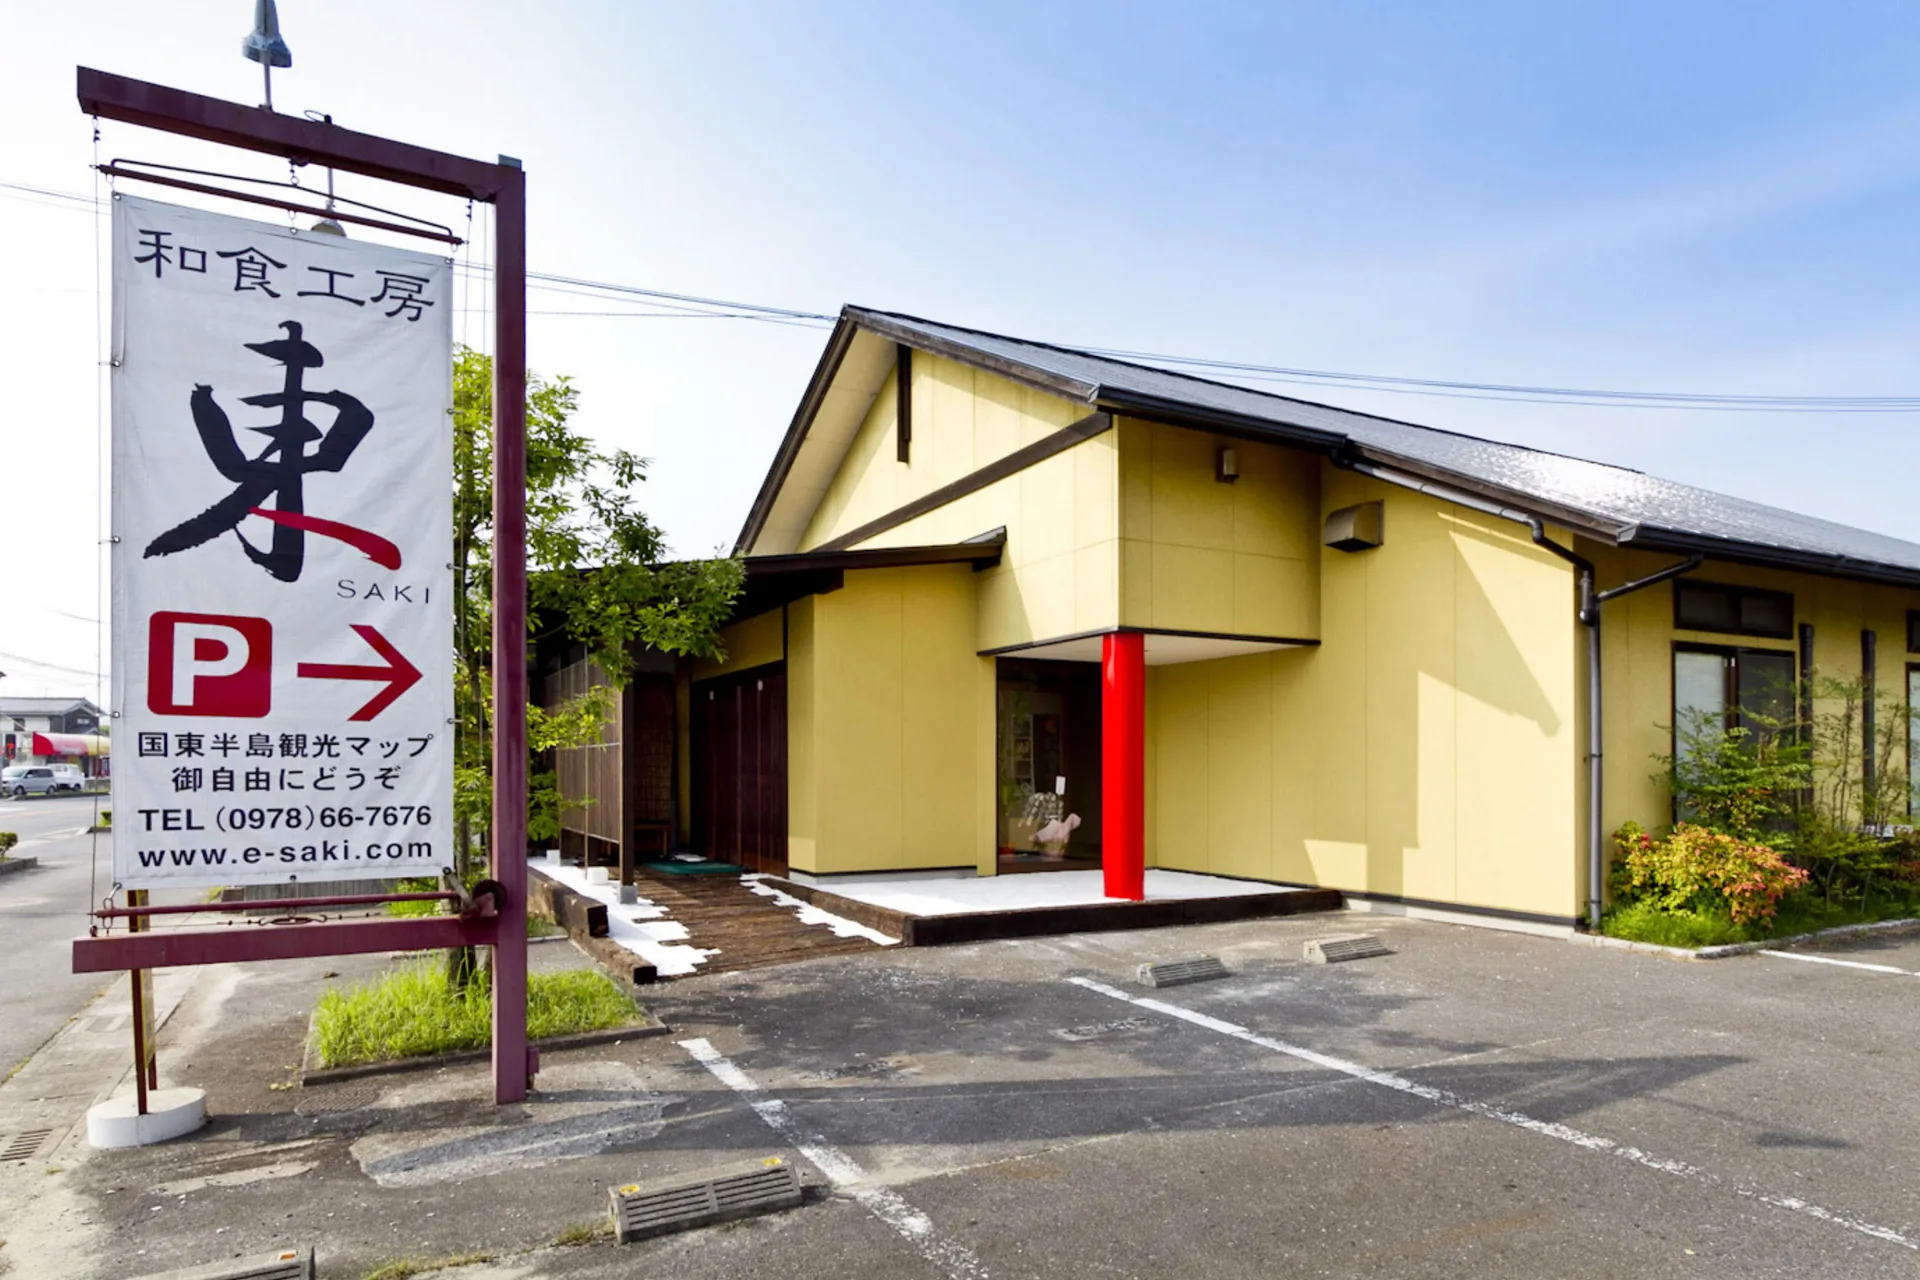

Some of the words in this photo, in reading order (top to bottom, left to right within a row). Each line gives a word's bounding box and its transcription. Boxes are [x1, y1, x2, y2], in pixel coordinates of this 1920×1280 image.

[133, 228, 435, 322] 和食工房
[336, 579, 430, 604] SAKI
[171, 621, 250, 707] P
[138, 732, 434, 759] 国東半島観光マップ
[171, 765, 401, 793] 御自由にどうぞ
[138, 808, 205, 832] TEL
[215, 804, 432, 833] (0978)66-7676
[138, 839, 432, 868] www.e-saki.com
